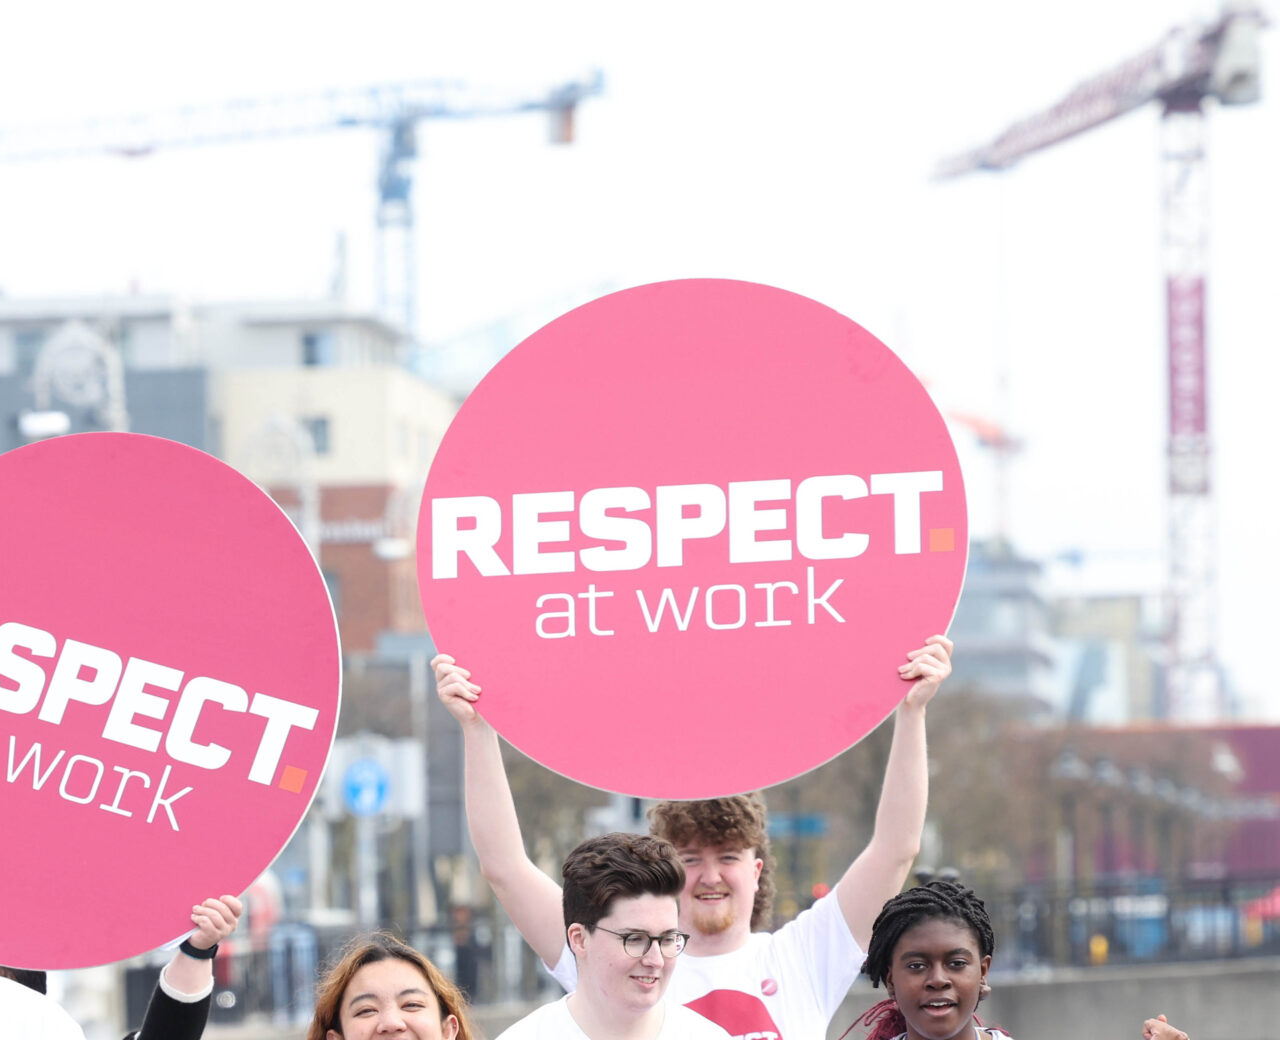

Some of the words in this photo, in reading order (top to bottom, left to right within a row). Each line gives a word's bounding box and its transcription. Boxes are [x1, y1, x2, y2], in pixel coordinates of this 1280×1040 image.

[431, 470, 955, 580] RESPECT.
[535, 584, 615, 639] at
[635, 566, 846, 633] work
[6, 736, 193, 832] work
